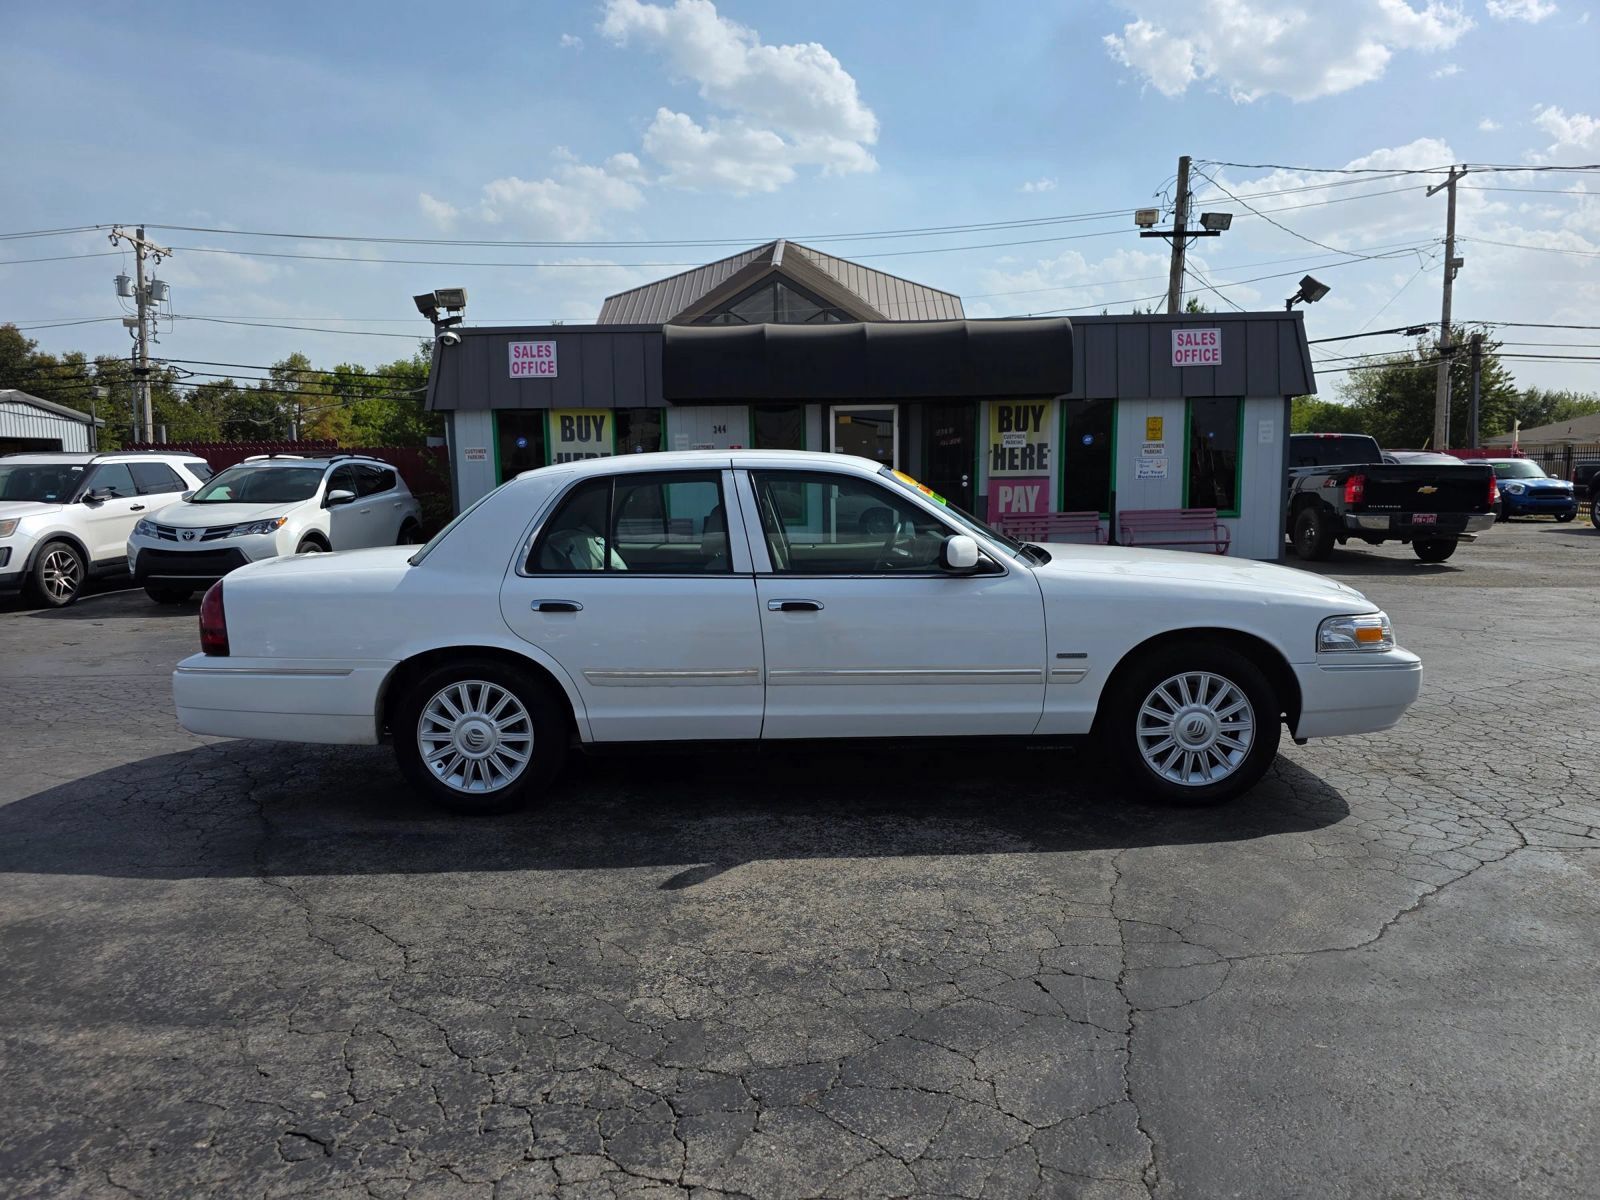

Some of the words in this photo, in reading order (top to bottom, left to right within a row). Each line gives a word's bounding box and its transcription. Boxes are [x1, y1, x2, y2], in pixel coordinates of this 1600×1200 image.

[1177, 332, 1216, 347] SALES
[513, 344, 552, 359] SALES
[1175, 348, 1219, 363] OFFICE
[512, 360, 555, 375] OFFICE
[559, 415, 606, 442] BUY
[997, 405, 1045, 433] BUY
[992, 443, 1049, 471] HERE
[998, 485, 1040, 513] PAY
